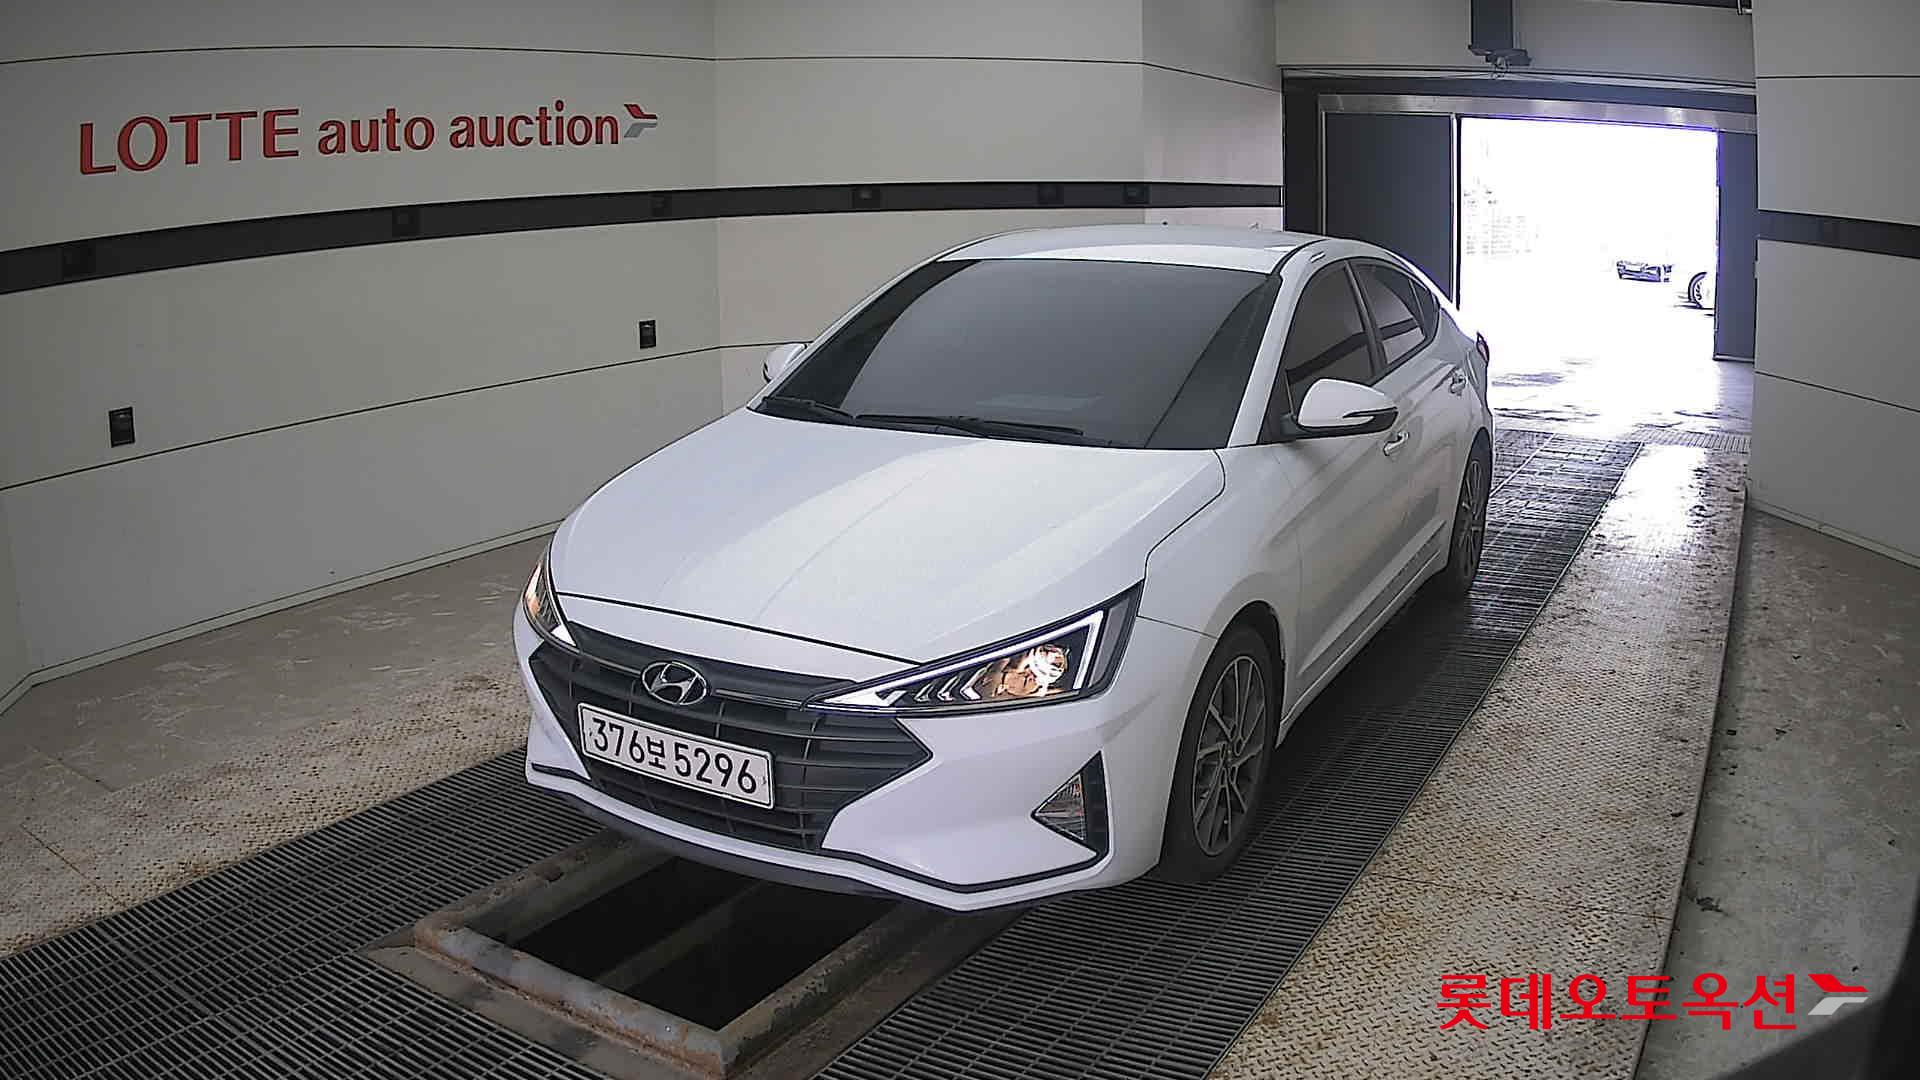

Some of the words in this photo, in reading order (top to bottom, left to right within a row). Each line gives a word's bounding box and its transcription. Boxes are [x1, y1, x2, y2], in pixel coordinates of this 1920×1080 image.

[80, 108, 299, 175] LOTTE
[317, 107, 435, 155] auto
[449, 99, 619, 149] auction
